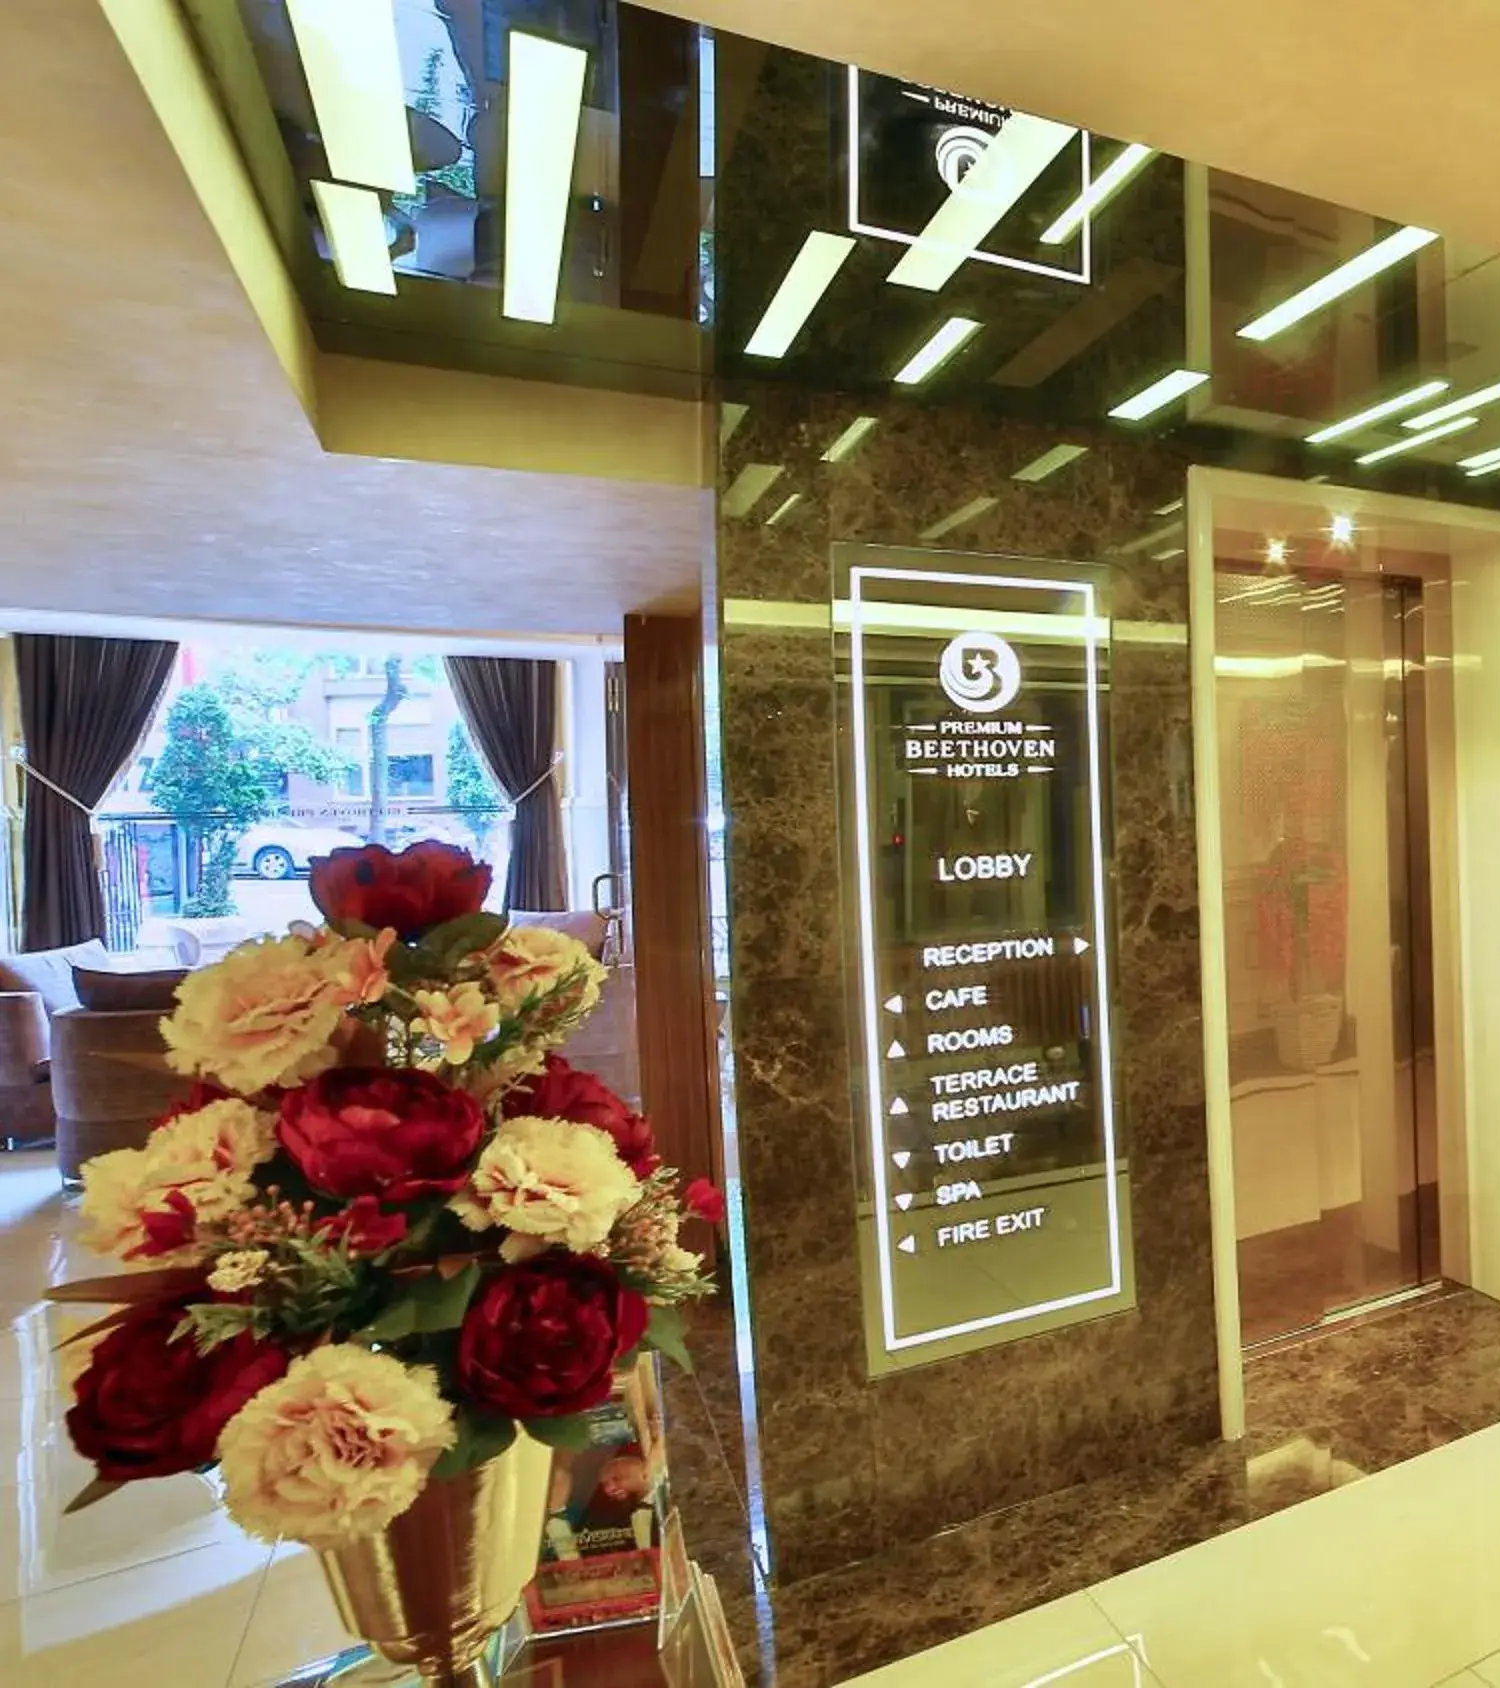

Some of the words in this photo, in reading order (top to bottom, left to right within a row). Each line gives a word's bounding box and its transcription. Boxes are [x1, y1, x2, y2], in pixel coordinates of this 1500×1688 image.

[940, 721, 1023, 735] PREMIUM
[906, 739, 1055, 758] BEETHOVEN
[947, 763, 1019, 777] HOTELS
[938, 853, 1032, 881] LOBBY
[923, 937, 1054, 967] RECEPTION
[925, 985, 988, 1011] CAFE
[927, 1025, 1013, 1054] ROOMS
[930, 1062, 1038, 1095] TERRACE
[932, 1081, 1080, 1122] RESTAURANT
[933, 1133, 1014, 1164] TOILET
[936, 1180, 982, 1206] SPA
[937, 1219, 990, 1247] FIRE
[996, 1207, 1045, 1235] EXIT
